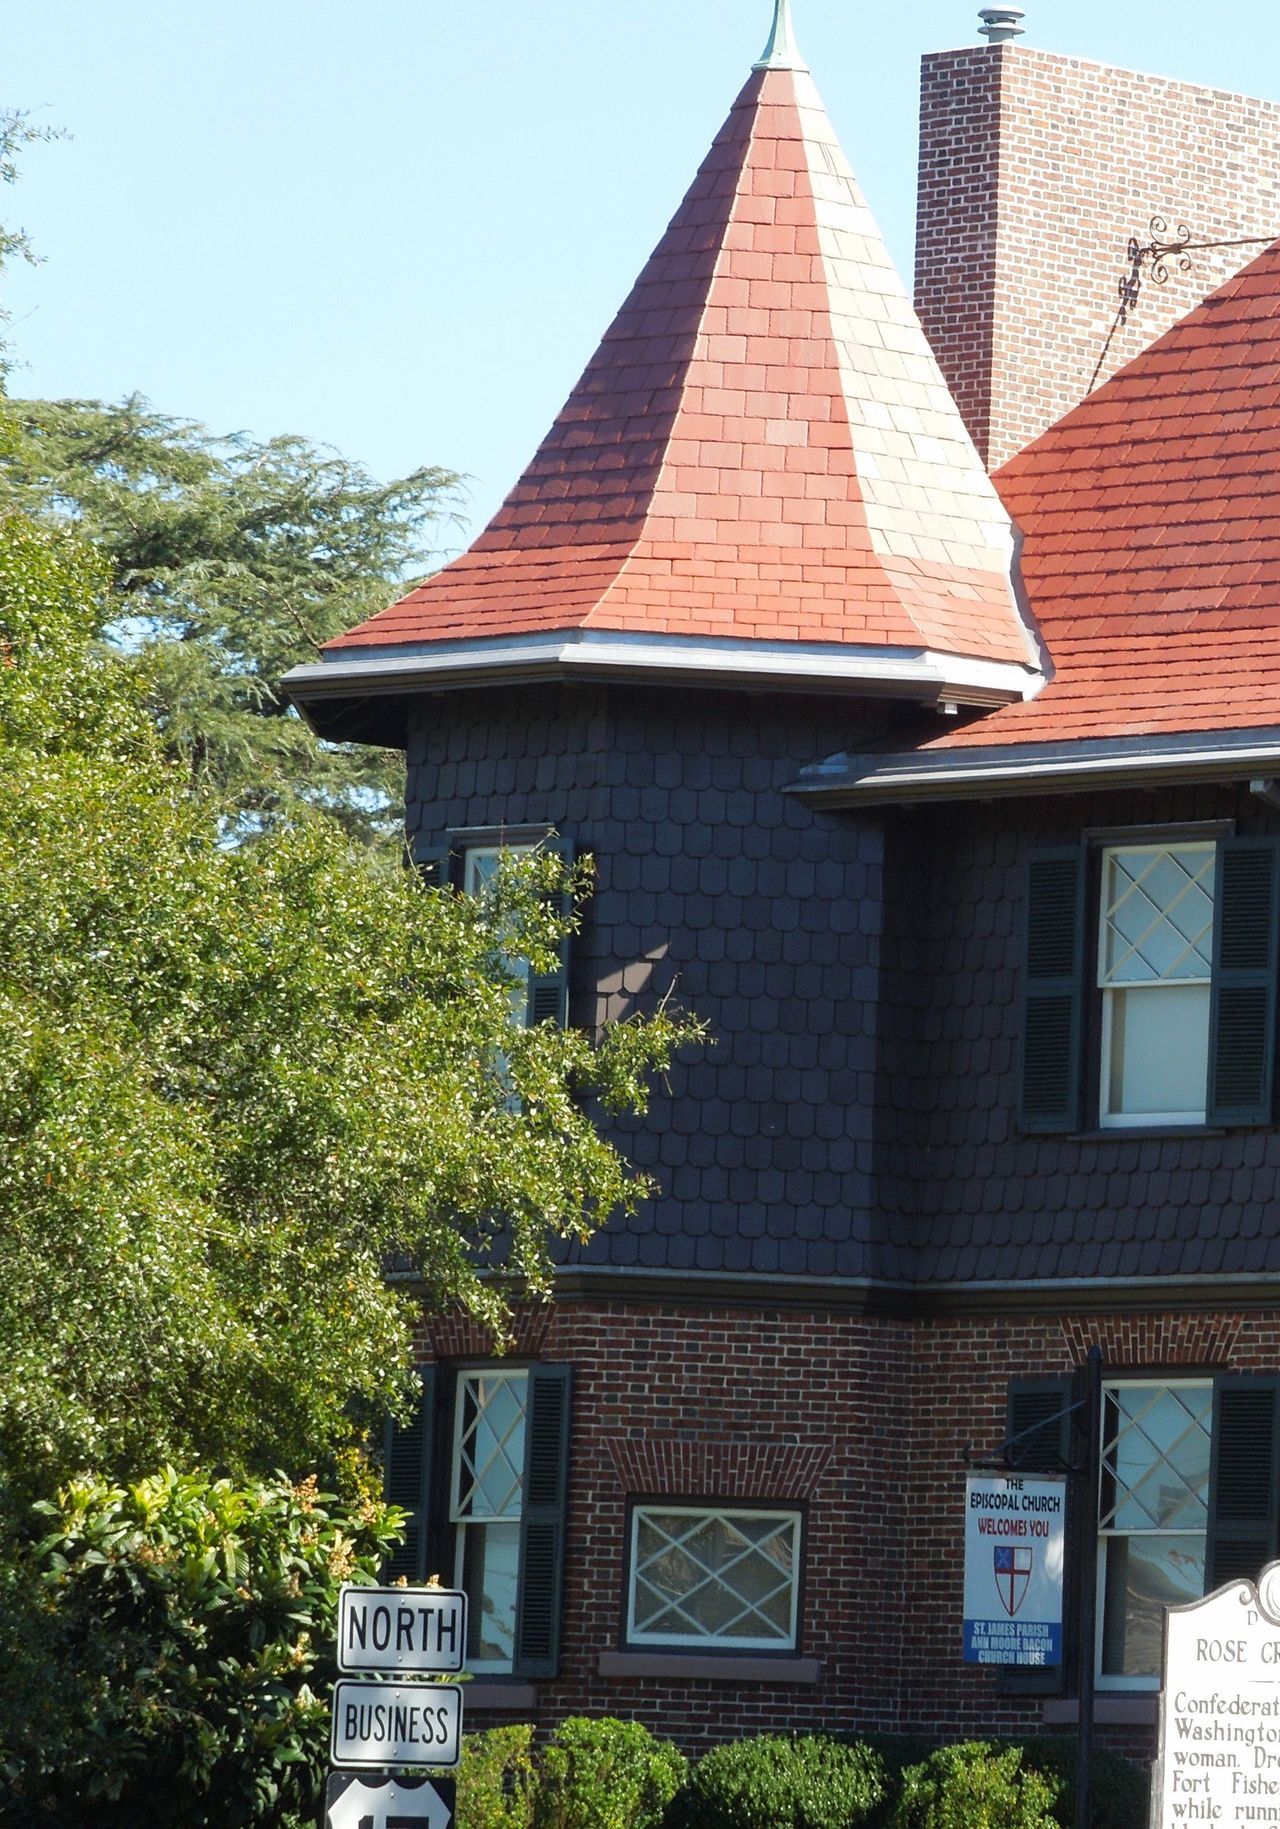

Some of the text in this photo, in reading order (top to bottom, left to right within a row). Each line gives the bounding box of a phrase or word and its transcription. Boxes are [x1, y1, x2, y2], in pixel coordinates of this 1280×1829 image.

[1006, 1478, 1024, 1491] THE
[971, 1492, 1060, 1512] EPISCOPAL CHURCH
[978, 1518, 1049, 1537] WELCOMES YOU
[1248, 1610, 1258, 1626] D
[349, 1606, 456, 1652] NORTH
[987, 1623, 1015, 1637] JAMES
[1016, 1624, 1048, 1638] PARISH
[972, 1636, 1052, 1652] ANN MOORE BACON
[1196, 1638, 1247, 1663] ROSE
[978, 1650, 1045, 1666] CHURCH HOUSE
[345, 1704, 448, 1744] BUSINESS
[1174, 1751, 1240, 1768] woman.
[1173, 1770, 1210, 1793] Fort
[1172, 1798, 1222, 1820] while
